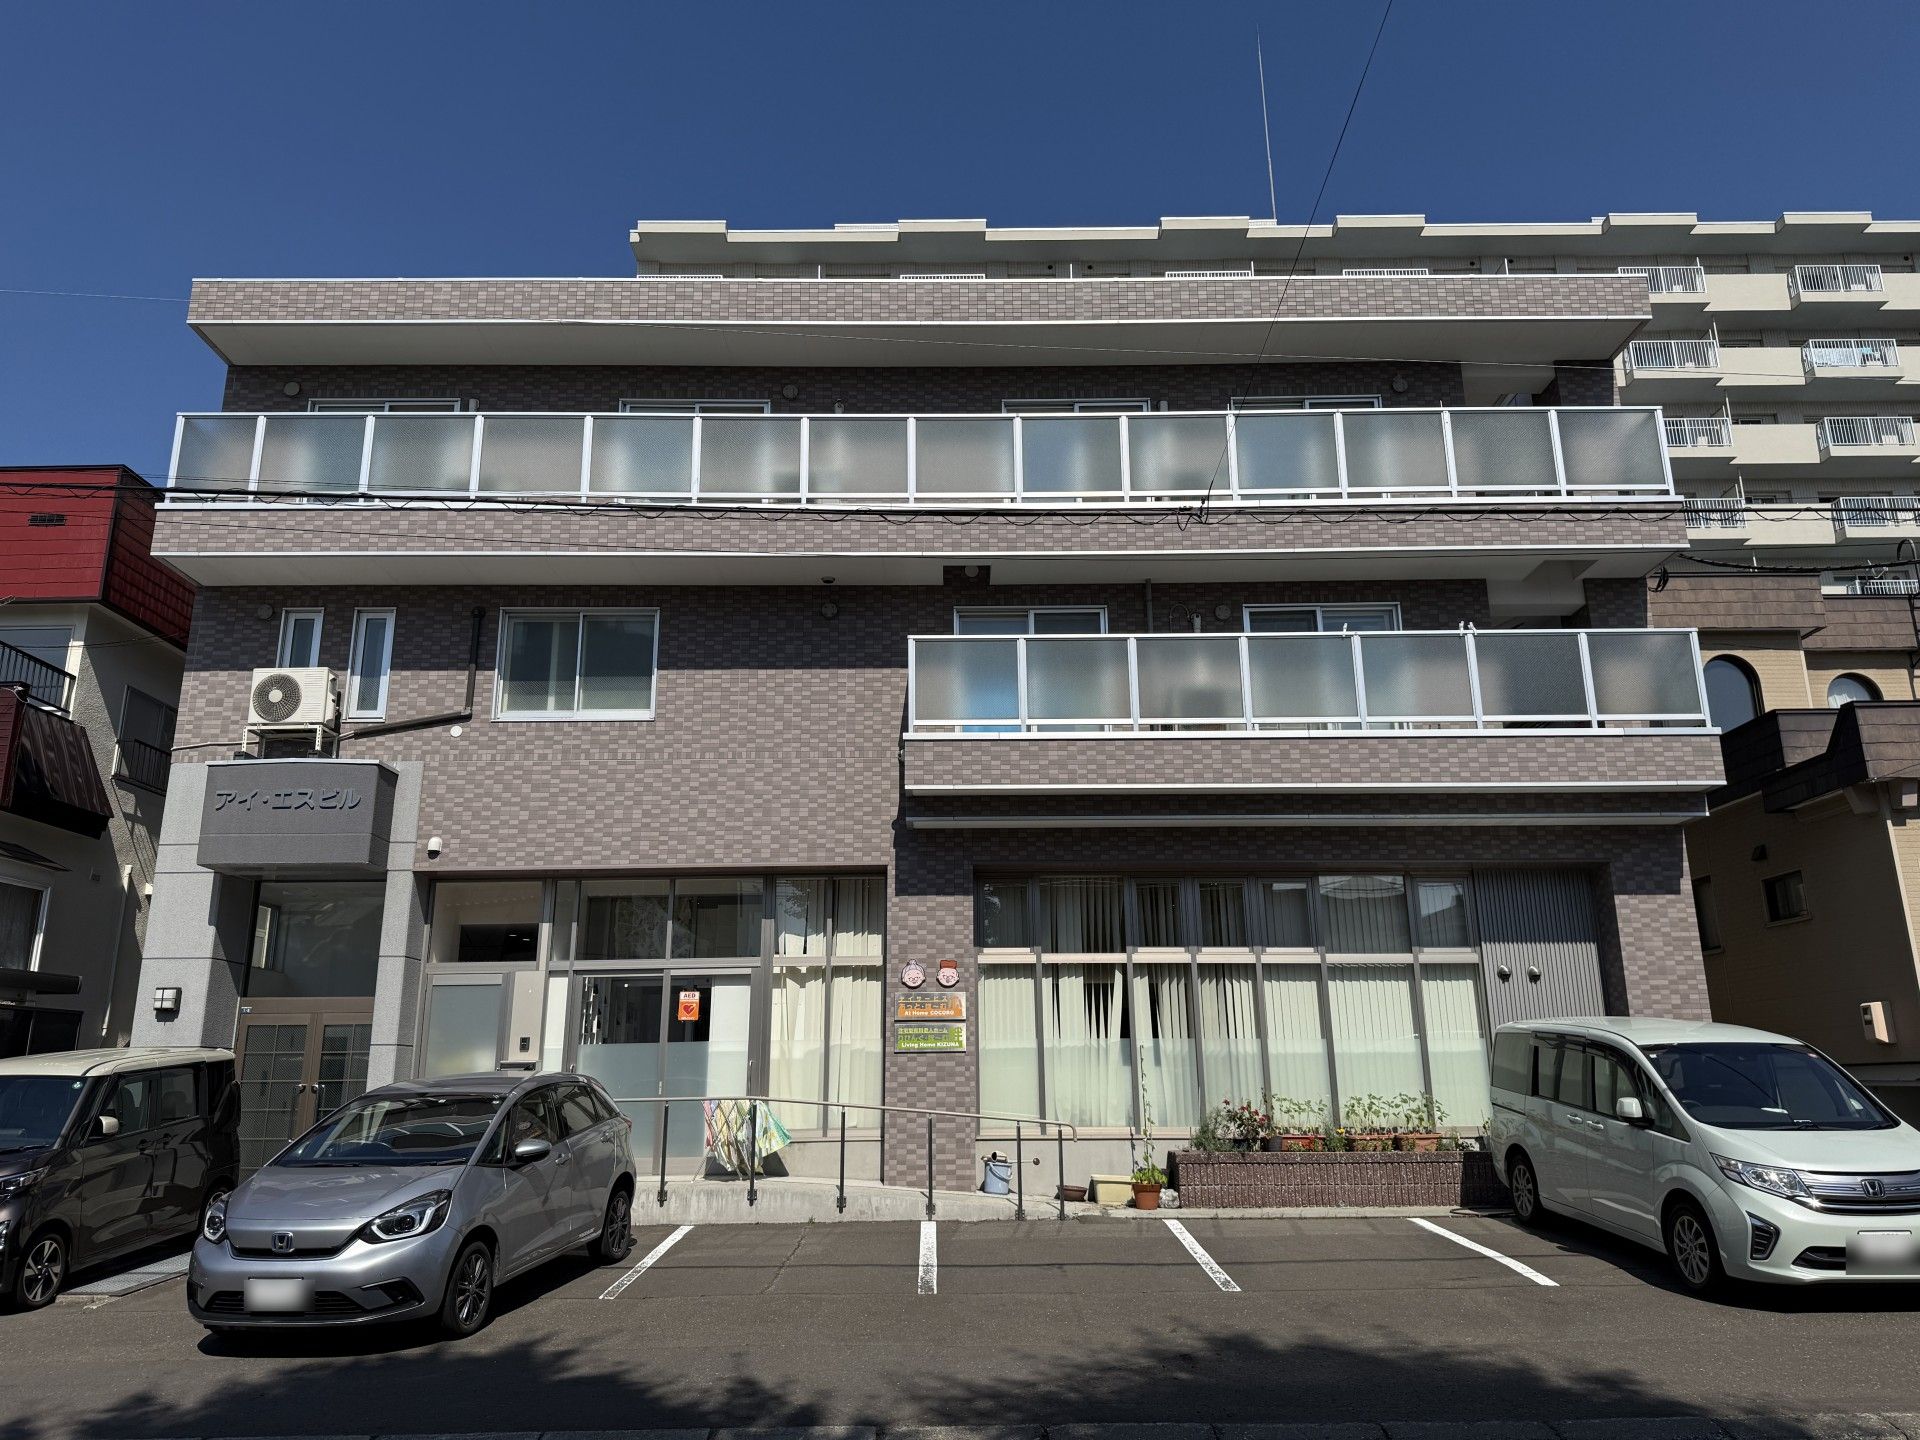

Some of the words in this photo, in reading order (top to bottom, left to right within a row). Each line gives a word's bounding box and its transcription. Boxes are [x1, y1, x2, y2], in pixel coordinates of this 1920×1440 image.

[215, 789, 362, 812] アイ・エスビル
